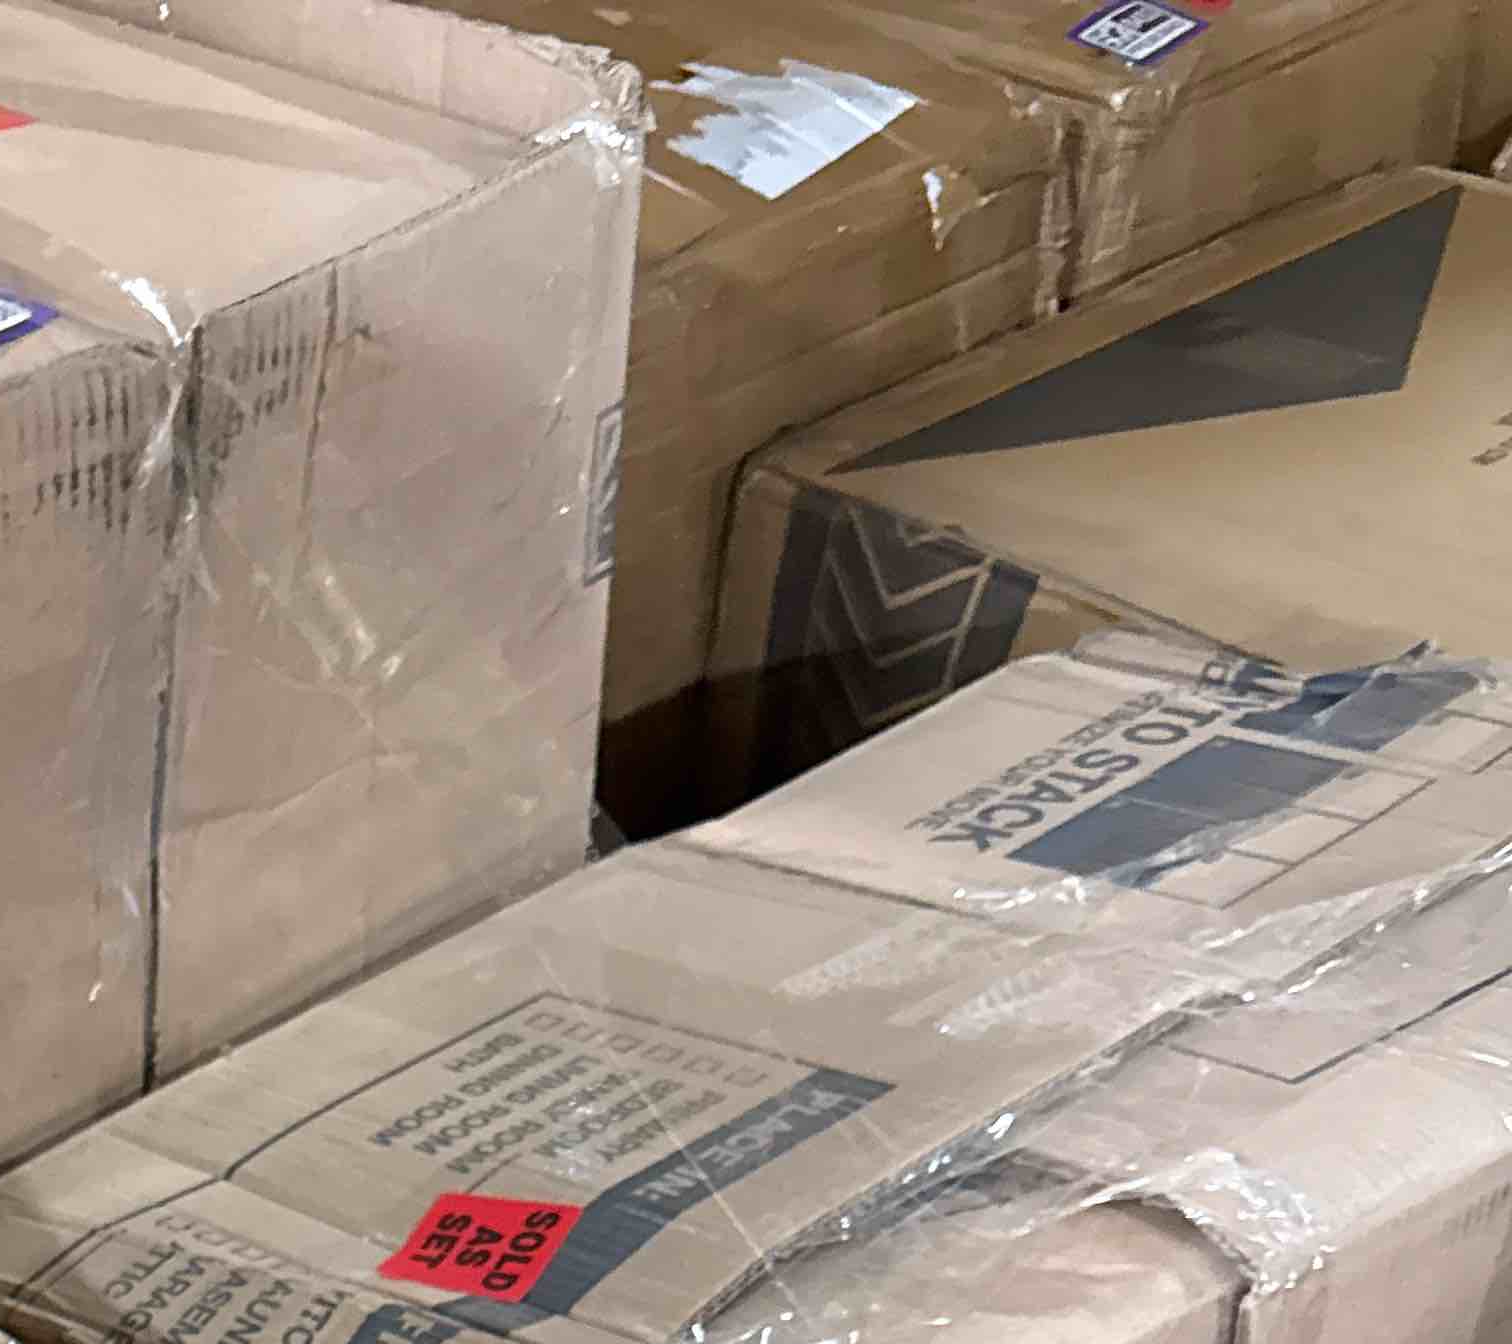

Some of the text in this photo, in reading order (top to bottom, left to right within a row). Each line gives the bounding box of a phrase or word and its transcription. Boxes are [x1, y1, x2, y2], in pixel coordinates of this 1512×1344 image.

[926, 703, 1223, 854] TO STACK
[363, 1093, 471, 1148] ROOM
[407, 1102, 516, 1157] ROOM
[438, 1117, 550, 1175] ROOM
[691, 1087, 852, 1167] PLACE
[410, 1212, 473, 1269] SET
[456, 1226, 503, 1268] AS
[482, 1210, 561, 1292] SOLD
